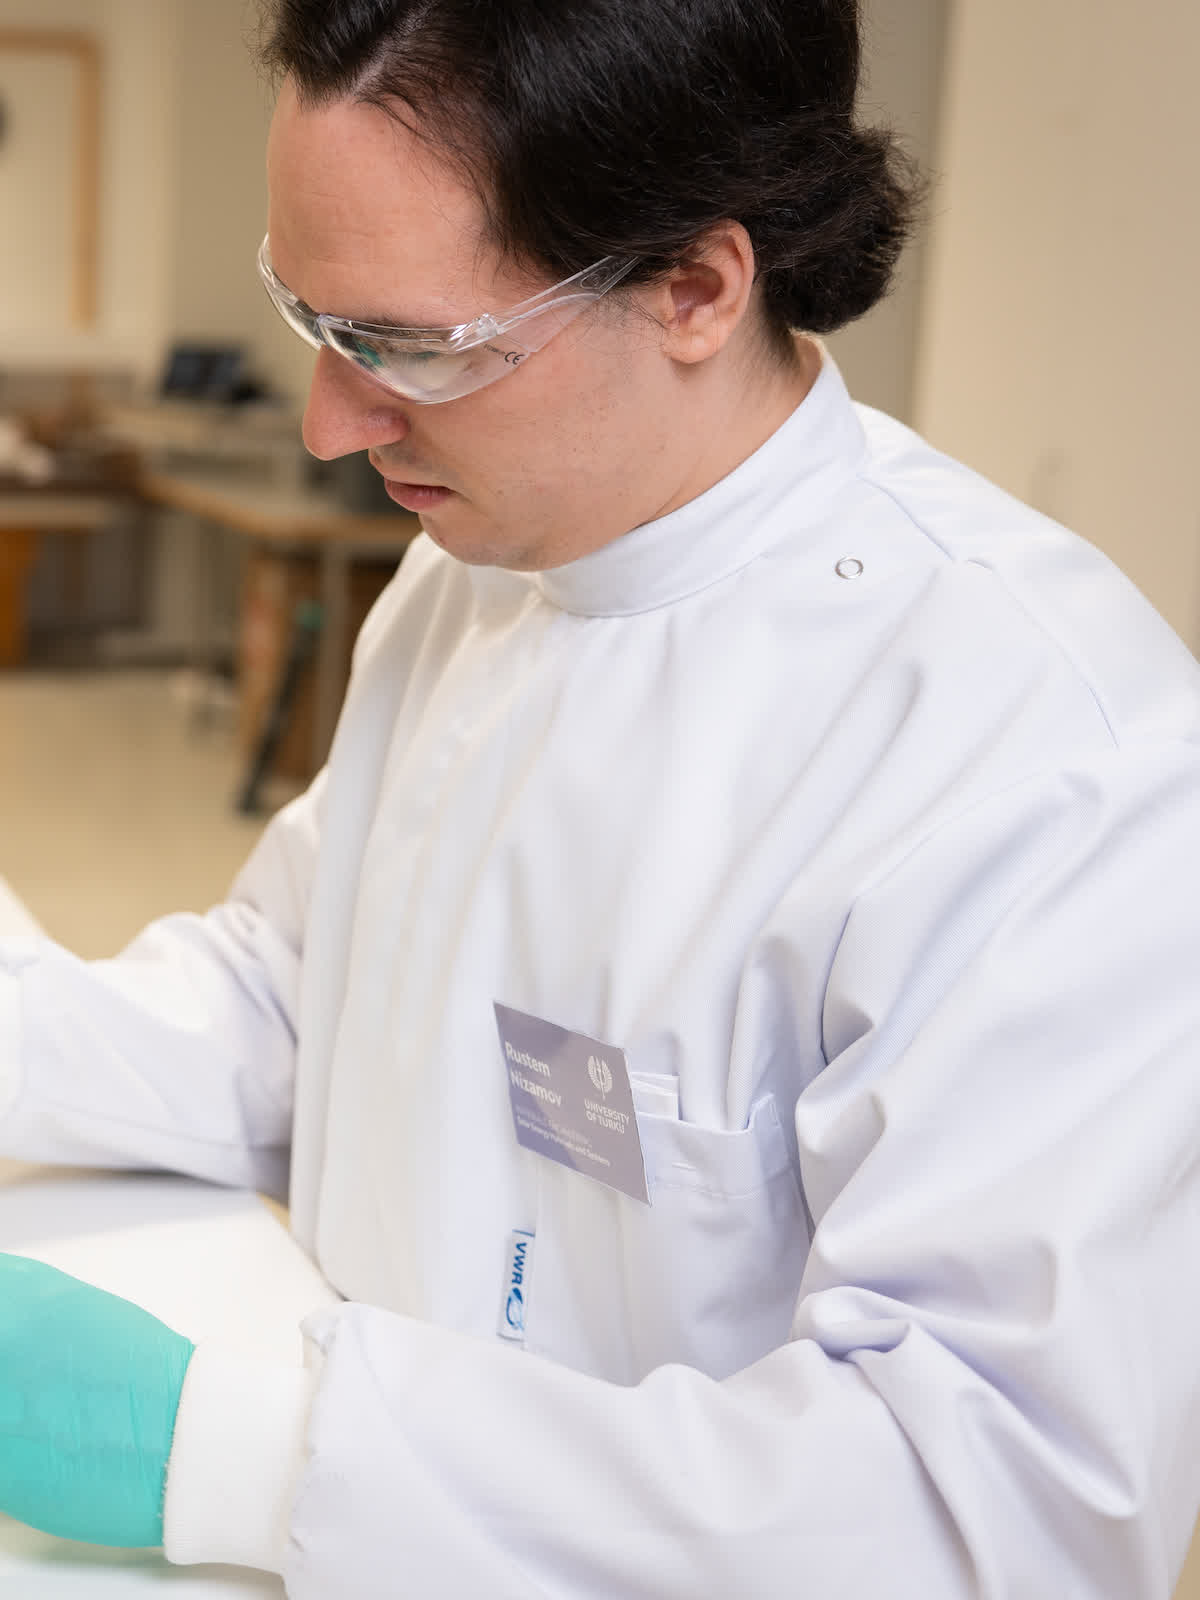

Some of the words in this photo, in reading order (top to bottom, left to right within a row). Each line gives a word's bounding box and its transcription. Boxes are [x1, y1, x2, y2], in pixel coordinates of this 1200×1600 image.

[505, 1041, 550, 1077] Rustem
[511, 1069, 562, 1108] Nizamov
[584, 1098, 630, 1125] UNIVERSITY
[586, 1110, 599, 1123] OF
[599, 1114, 625, 1134] TURKU
[512, 1242, 527, 1285] VWR
